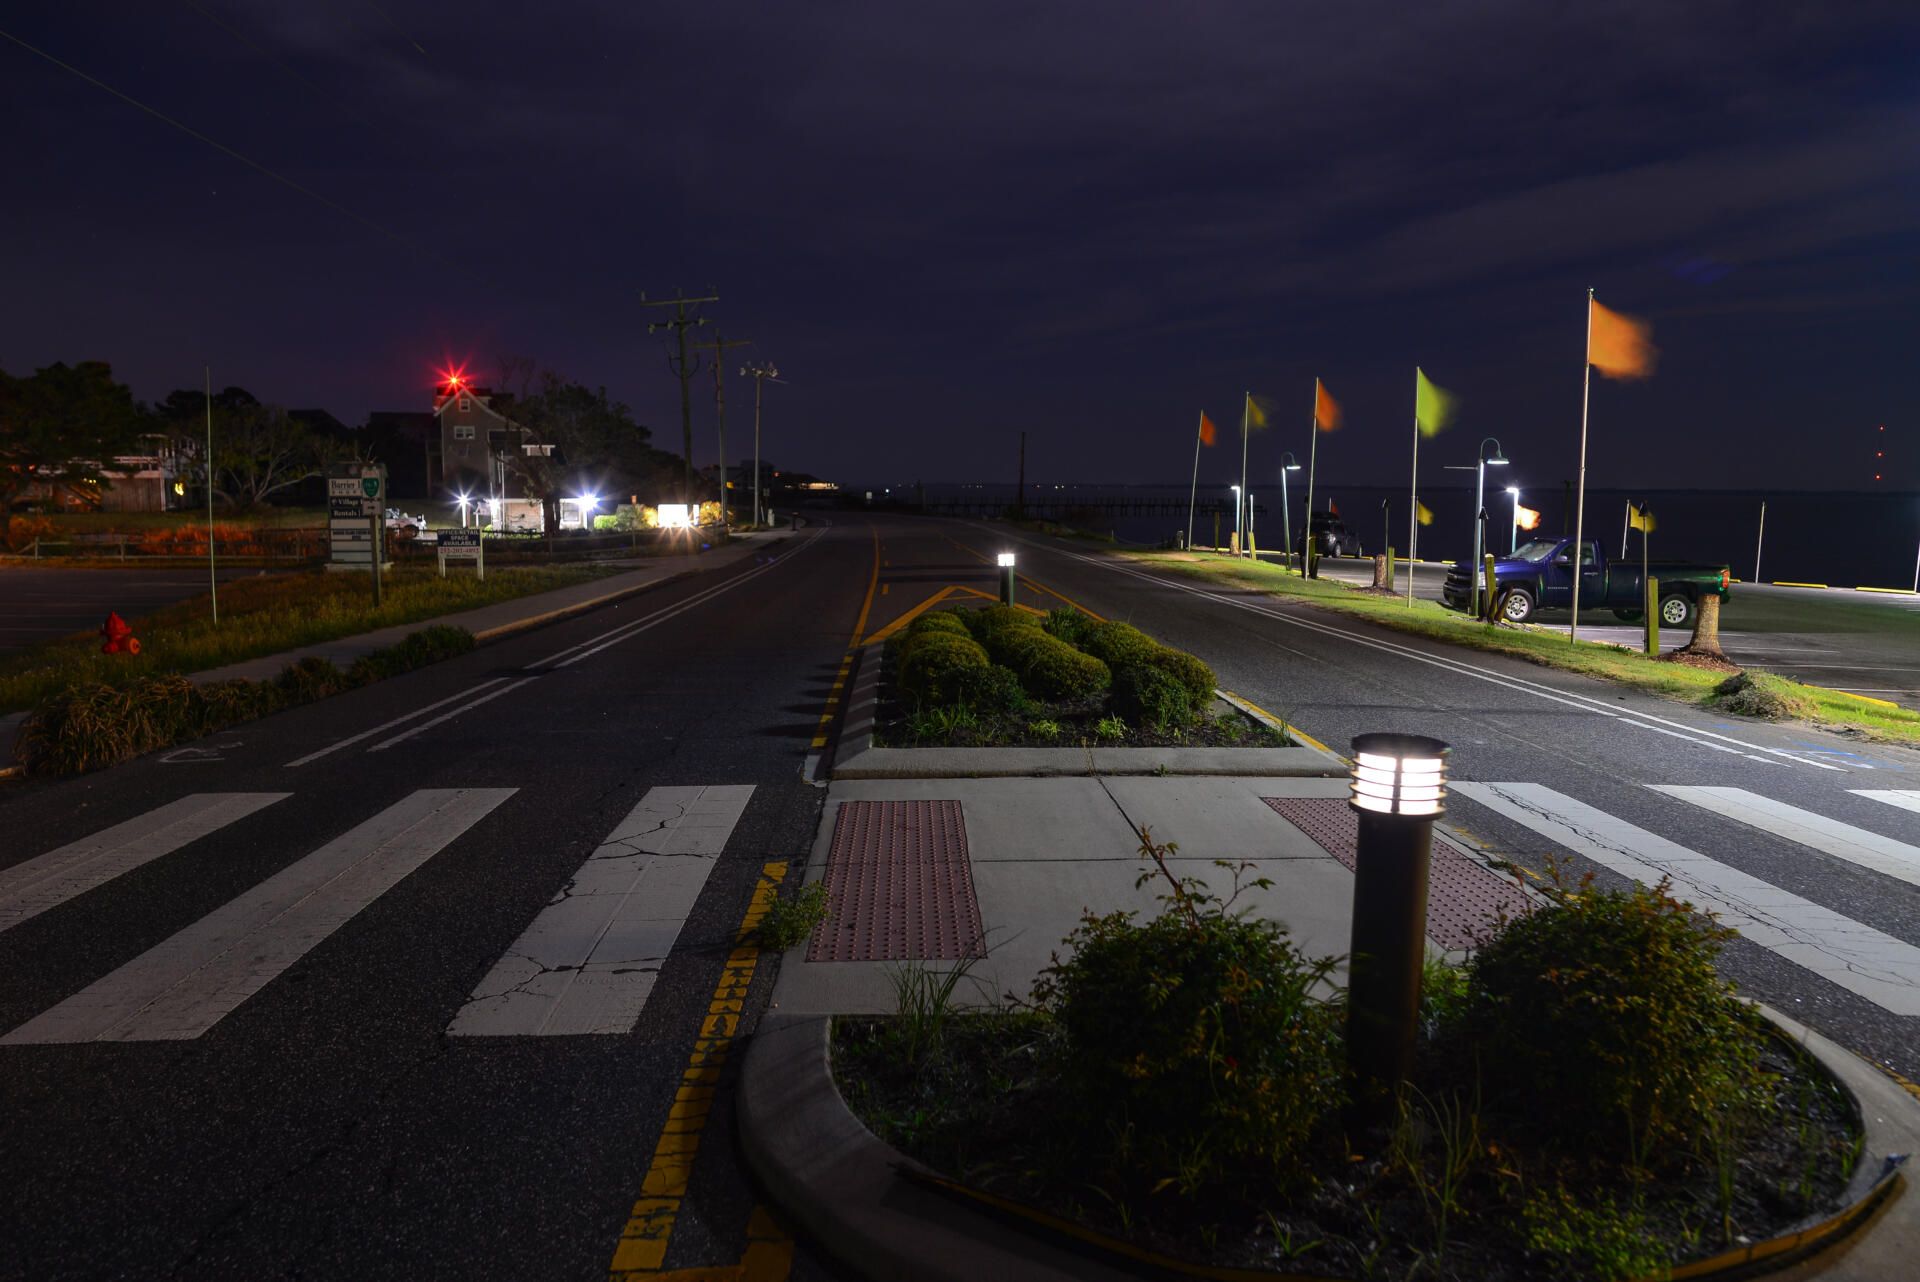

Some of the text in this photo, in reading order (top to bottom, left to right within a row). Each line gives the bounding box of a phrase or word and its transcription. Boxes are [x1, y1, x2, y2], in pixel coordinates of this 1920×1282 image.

[331, 479, 357, 489] Barrier
[338, 498, 360, 507] Village
[333, 509, 359, 517] Rentals
